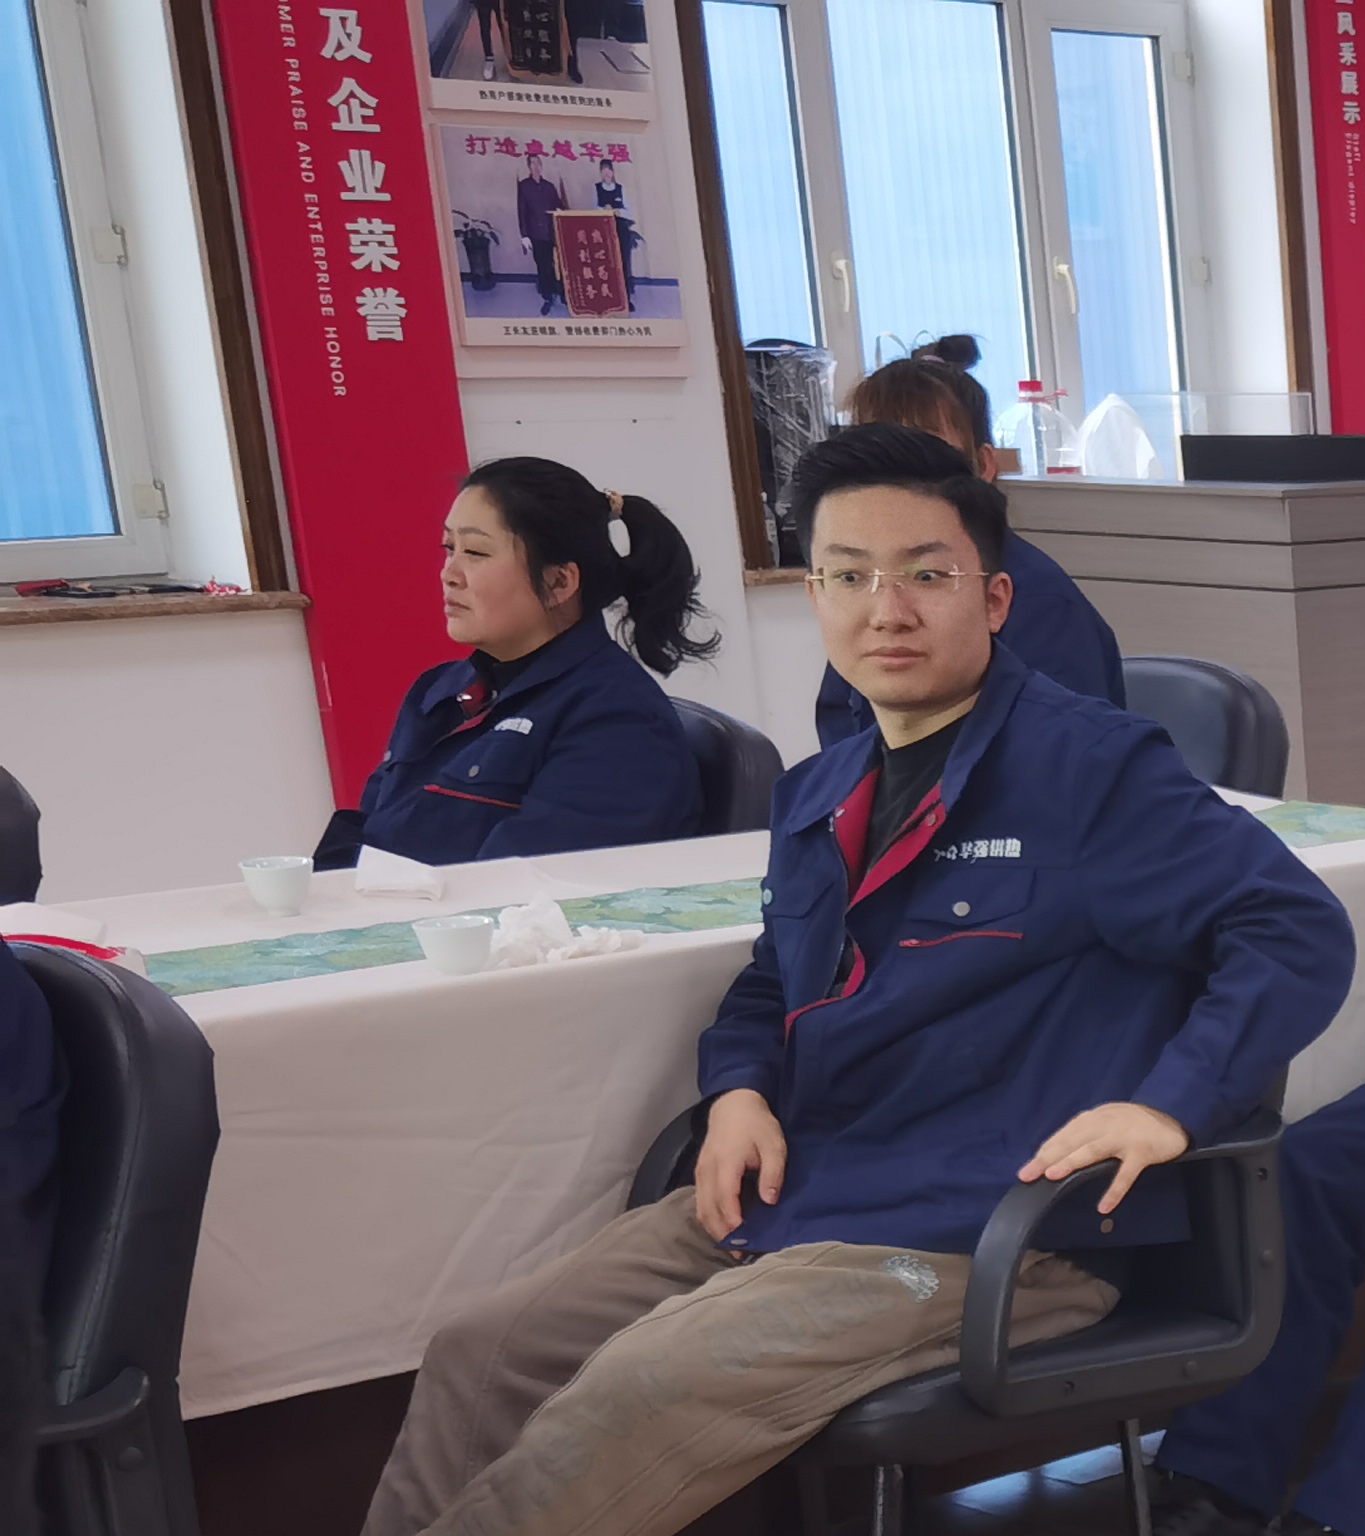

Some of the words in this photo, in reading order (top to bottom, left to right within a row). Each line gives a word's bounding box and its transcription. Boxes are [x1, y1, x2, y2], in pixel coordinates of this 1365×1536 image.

[277, 0, 296, 48] MER
[285, 58, 308, 131] PRAISE
[1335, 0, 1361, 125] 风采展示
[296, 141, 315, 183] AND
[318, 8, 408, 341] 及企业荣誉
[304, 193, 335, 317] ENTERPRISE
[323, 327, 347, 396] HONOR
[959, 838, 1021, 860] 华强供热
